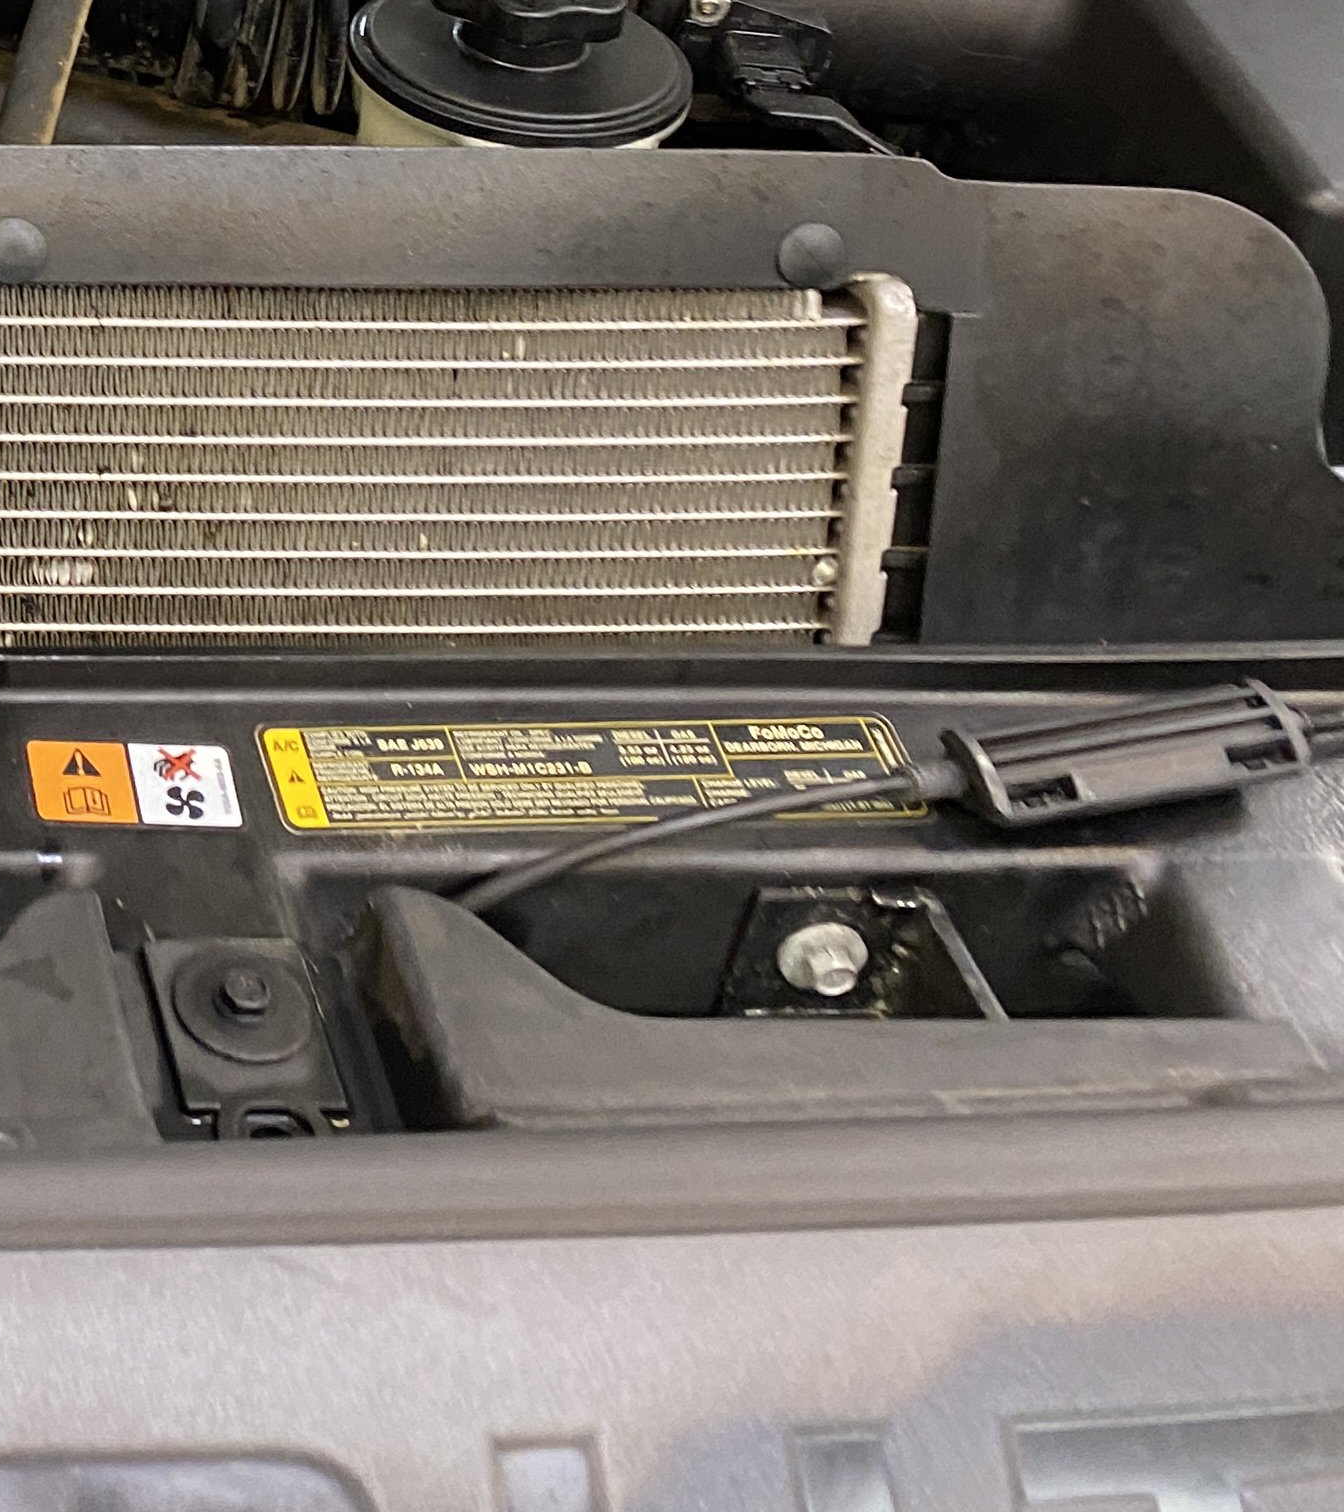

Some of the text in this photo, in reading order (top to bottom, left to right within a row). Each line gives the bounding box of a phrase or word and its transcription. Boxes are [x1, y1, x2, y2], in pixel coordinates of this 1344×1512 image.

[747, 725, 825, 740] FoMoCo
[273, 740, 300, 752] A/C
[390, 762, 445, 777] R-134A
